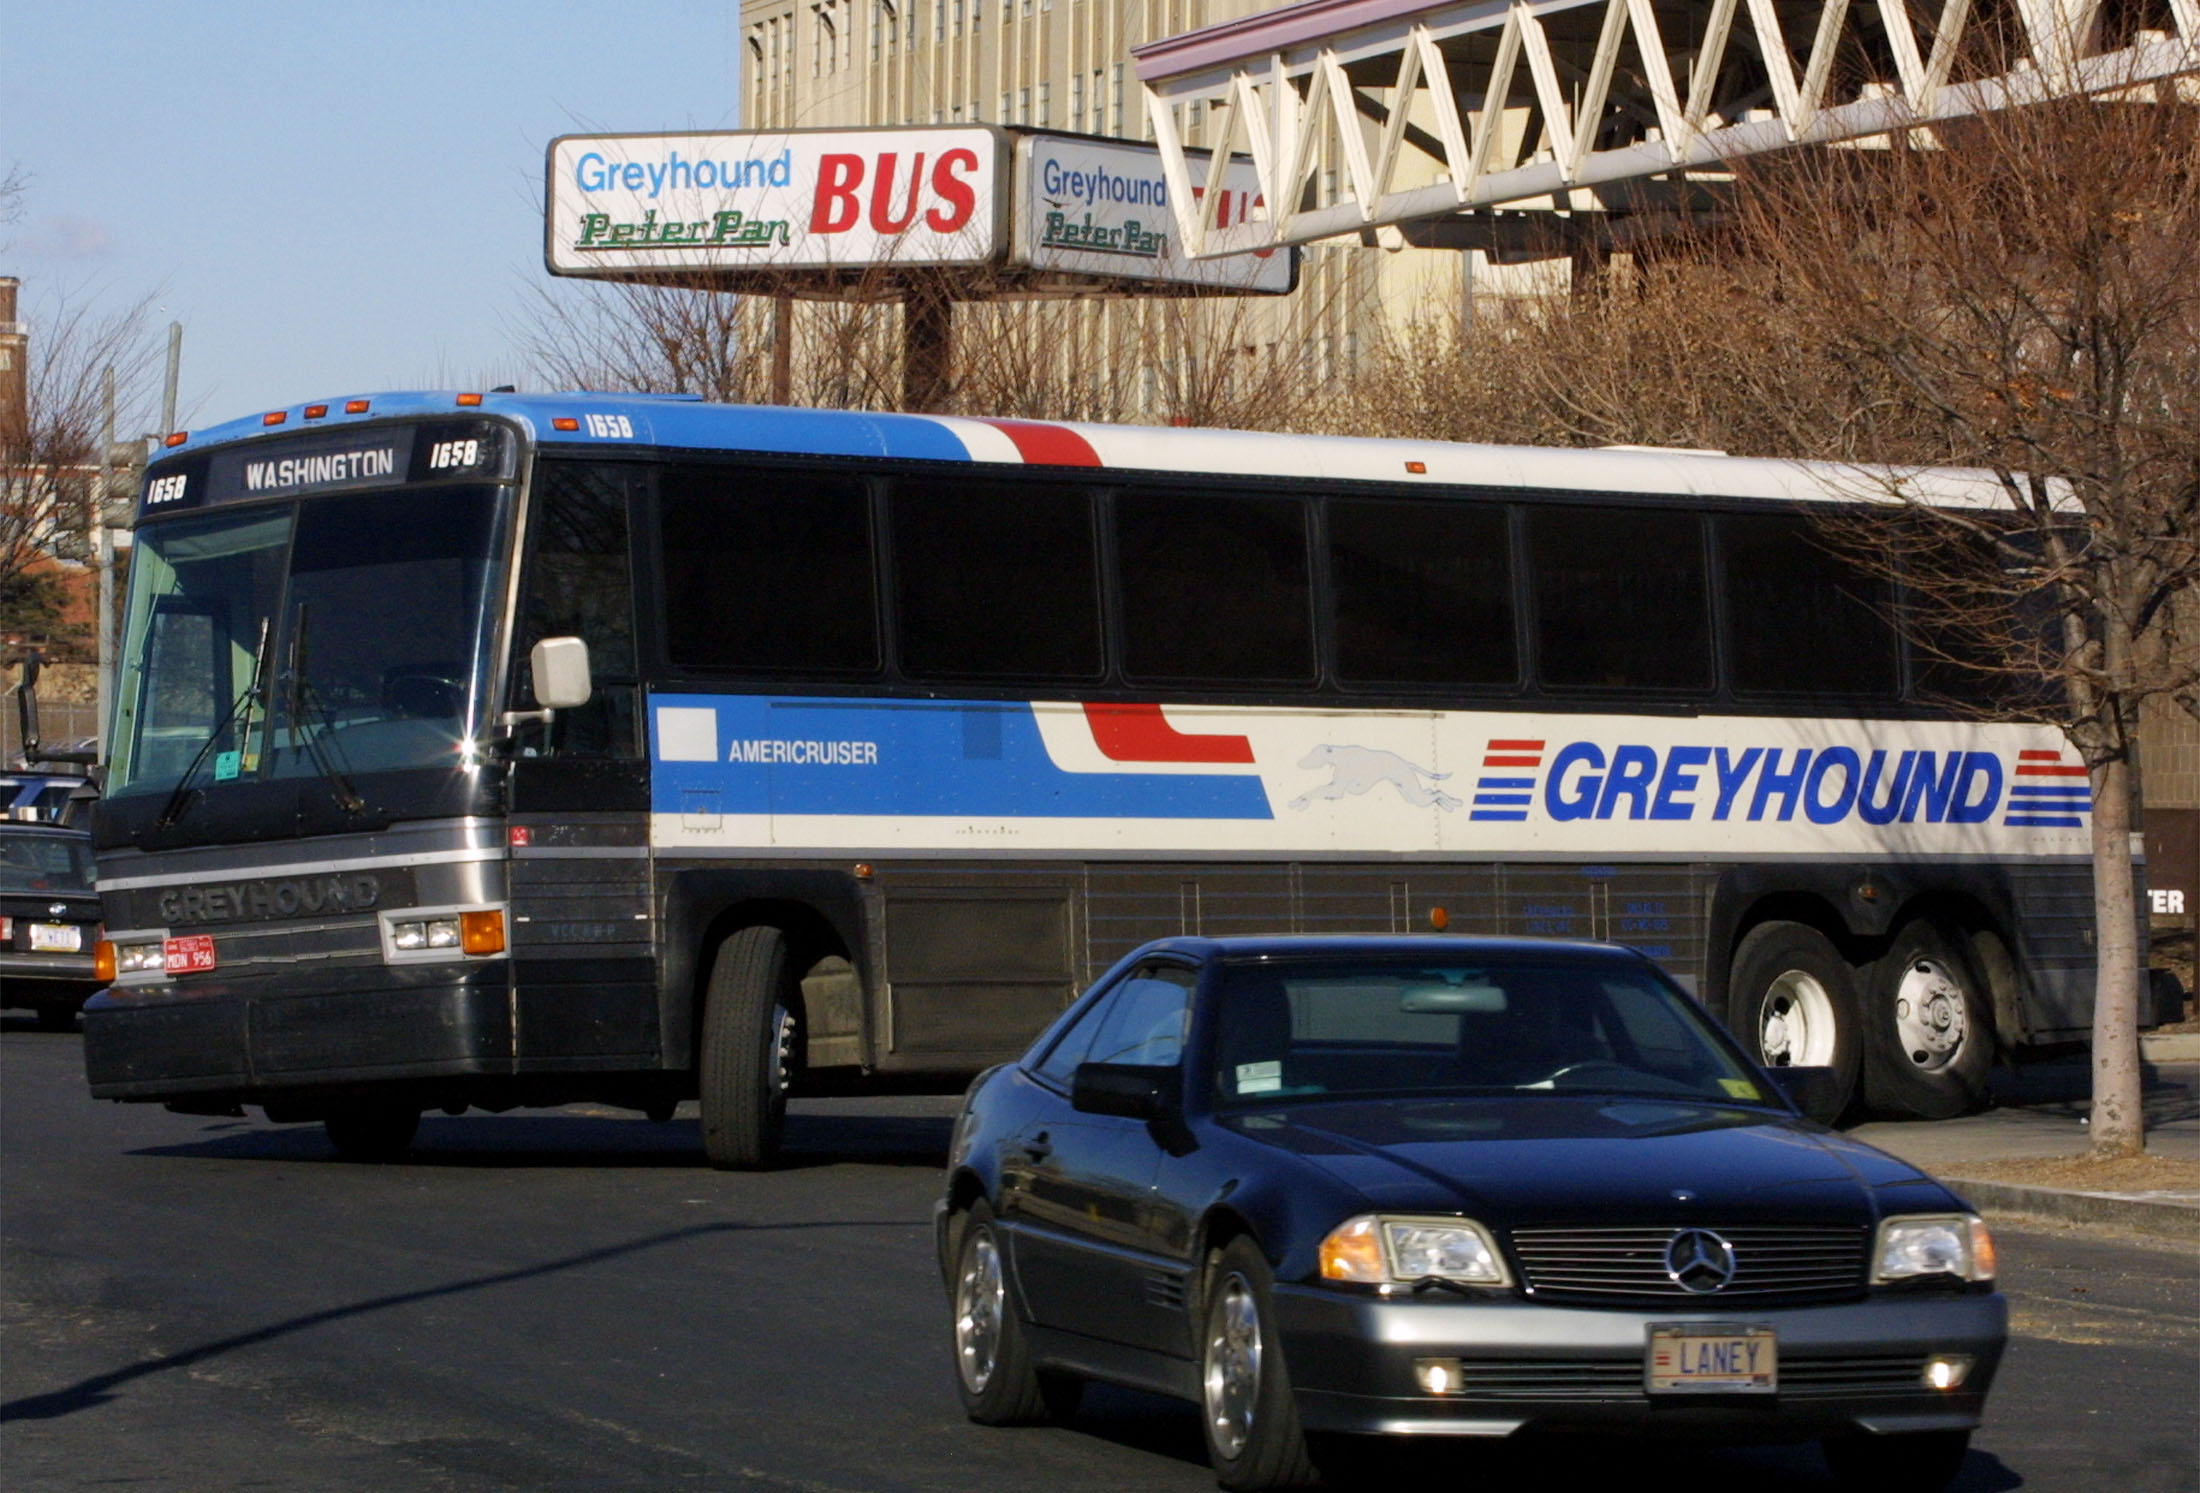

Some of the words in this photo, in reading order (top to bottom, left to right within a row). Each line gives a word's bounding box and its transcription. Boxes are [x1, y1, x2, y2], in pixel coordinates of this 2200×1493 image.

[576, 148, 791, 198] Greyhound
[808, 147, 979, 234] BUS
[1043, 158, 1166, 207] Greyhound
[576, 209, 709, 246] Peter
[708, 210, 790, 246] Pan
[1041, 211, 1121, 248] Peter
[1119, 219, 1168, 254] Pan
[584, 413, 633, 438] 1658
[246, 448, 394, 491] WASHINGTON
[430, 439, 477, 469] 1658
[146, 474, 187, 504] 1658
[729, 740, 878, 765] AMERICRUISER
[1544, 741, 2004, 825] GREYHOUND
[159, 875, 380, 923] GREYHOUND
[2147, 889, 2185, 914] ER
[1681, 1342, 1759, 1374] LANEY
